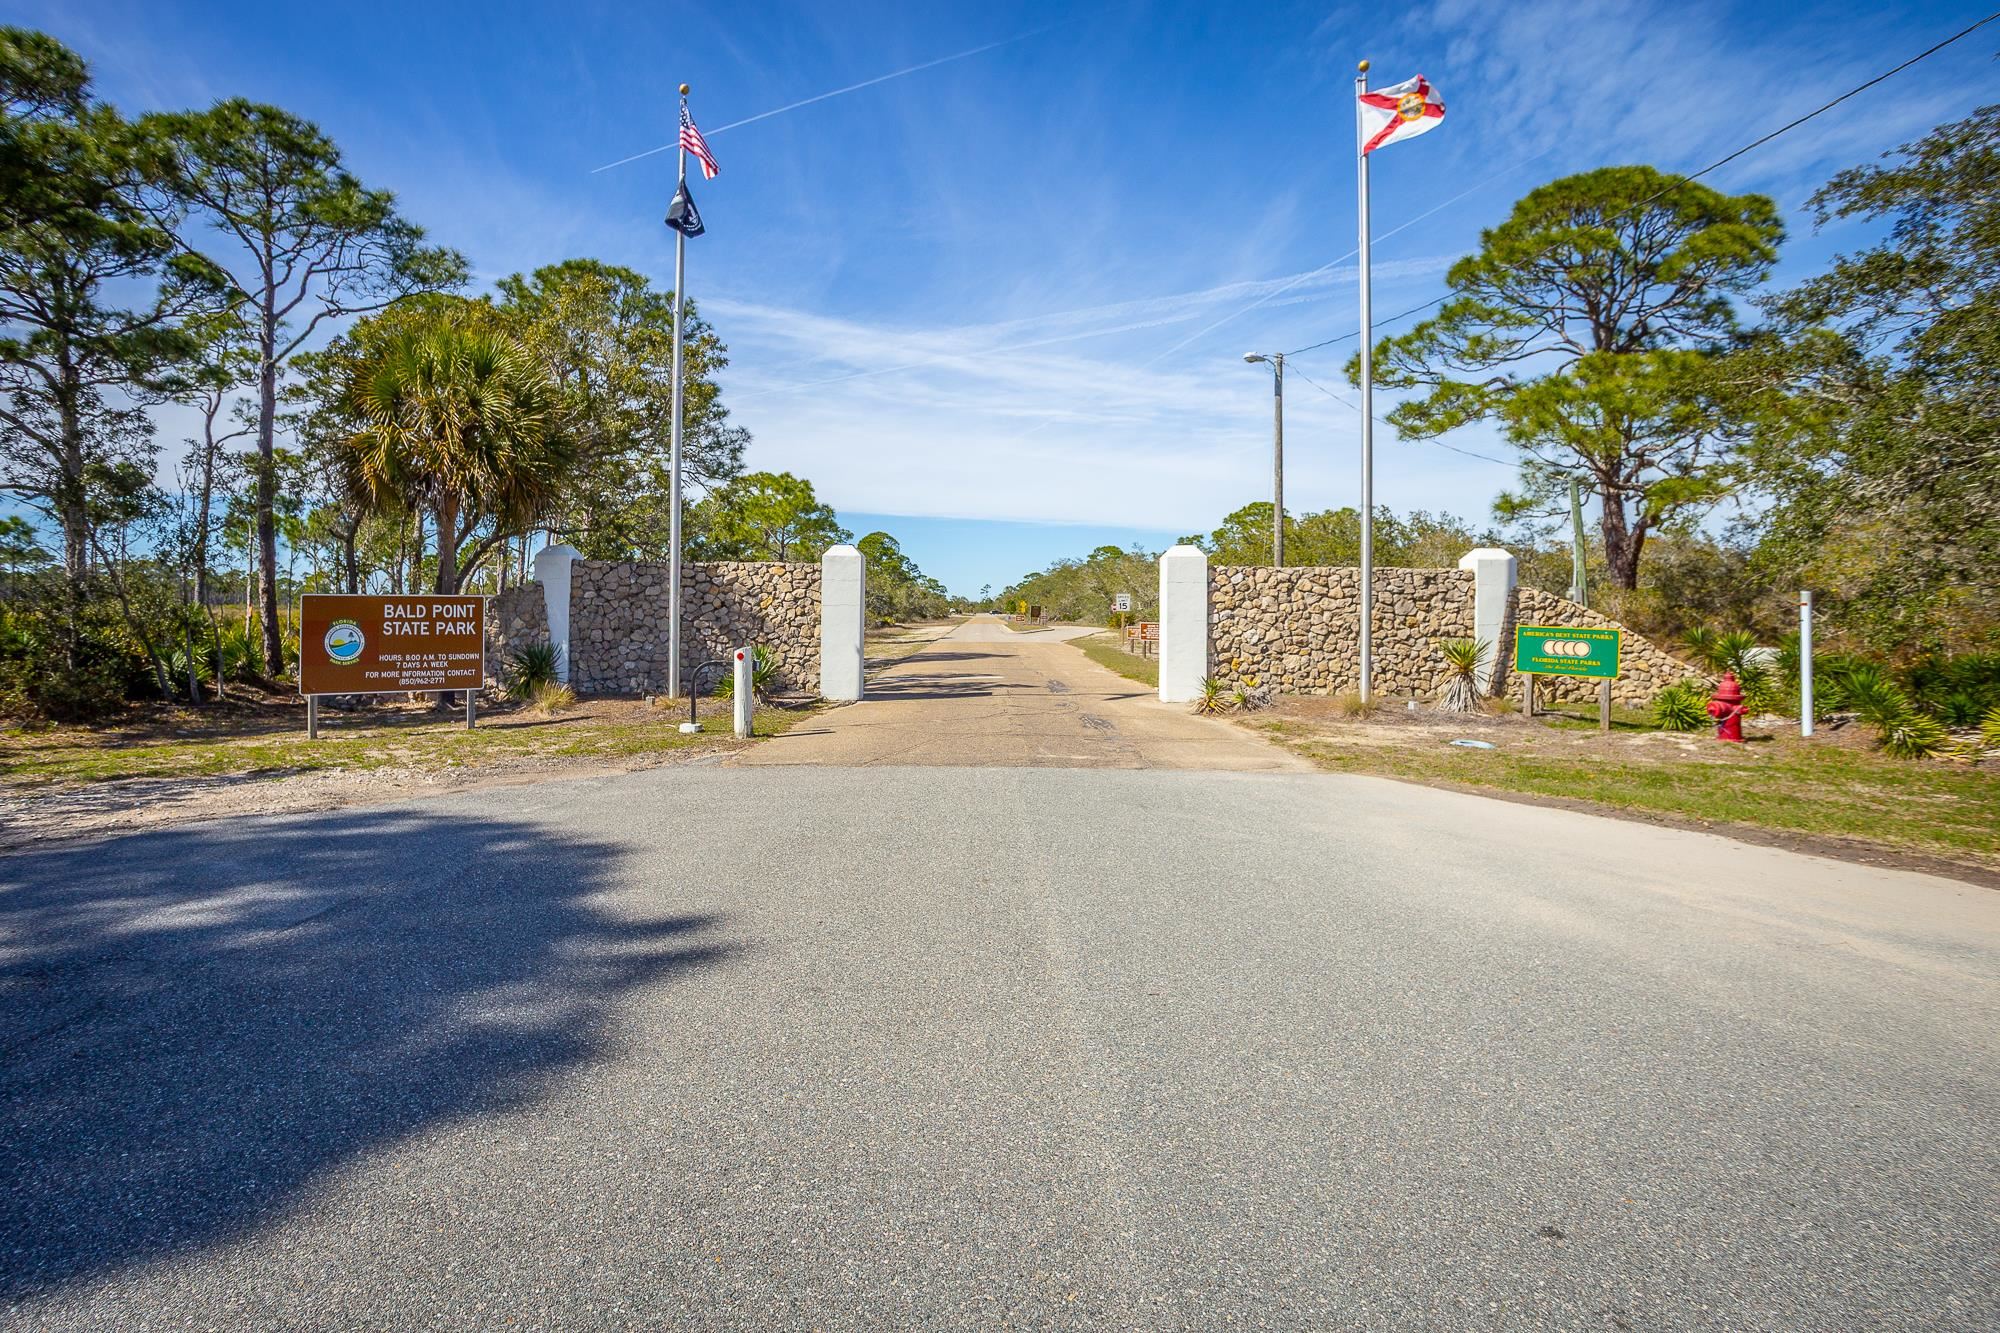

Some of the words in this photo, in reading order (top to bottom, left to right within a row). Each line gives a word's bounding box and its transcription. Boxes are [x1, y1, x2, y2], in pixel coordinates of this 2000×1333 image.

[384, 604, 426, 618] BALD
[432, 604, 476, 618] POINT
[383, 621, 429, 635] STATE
[435, 621, 476, 635] PARK
[398, 677, 445, 686] (850)962-2771
